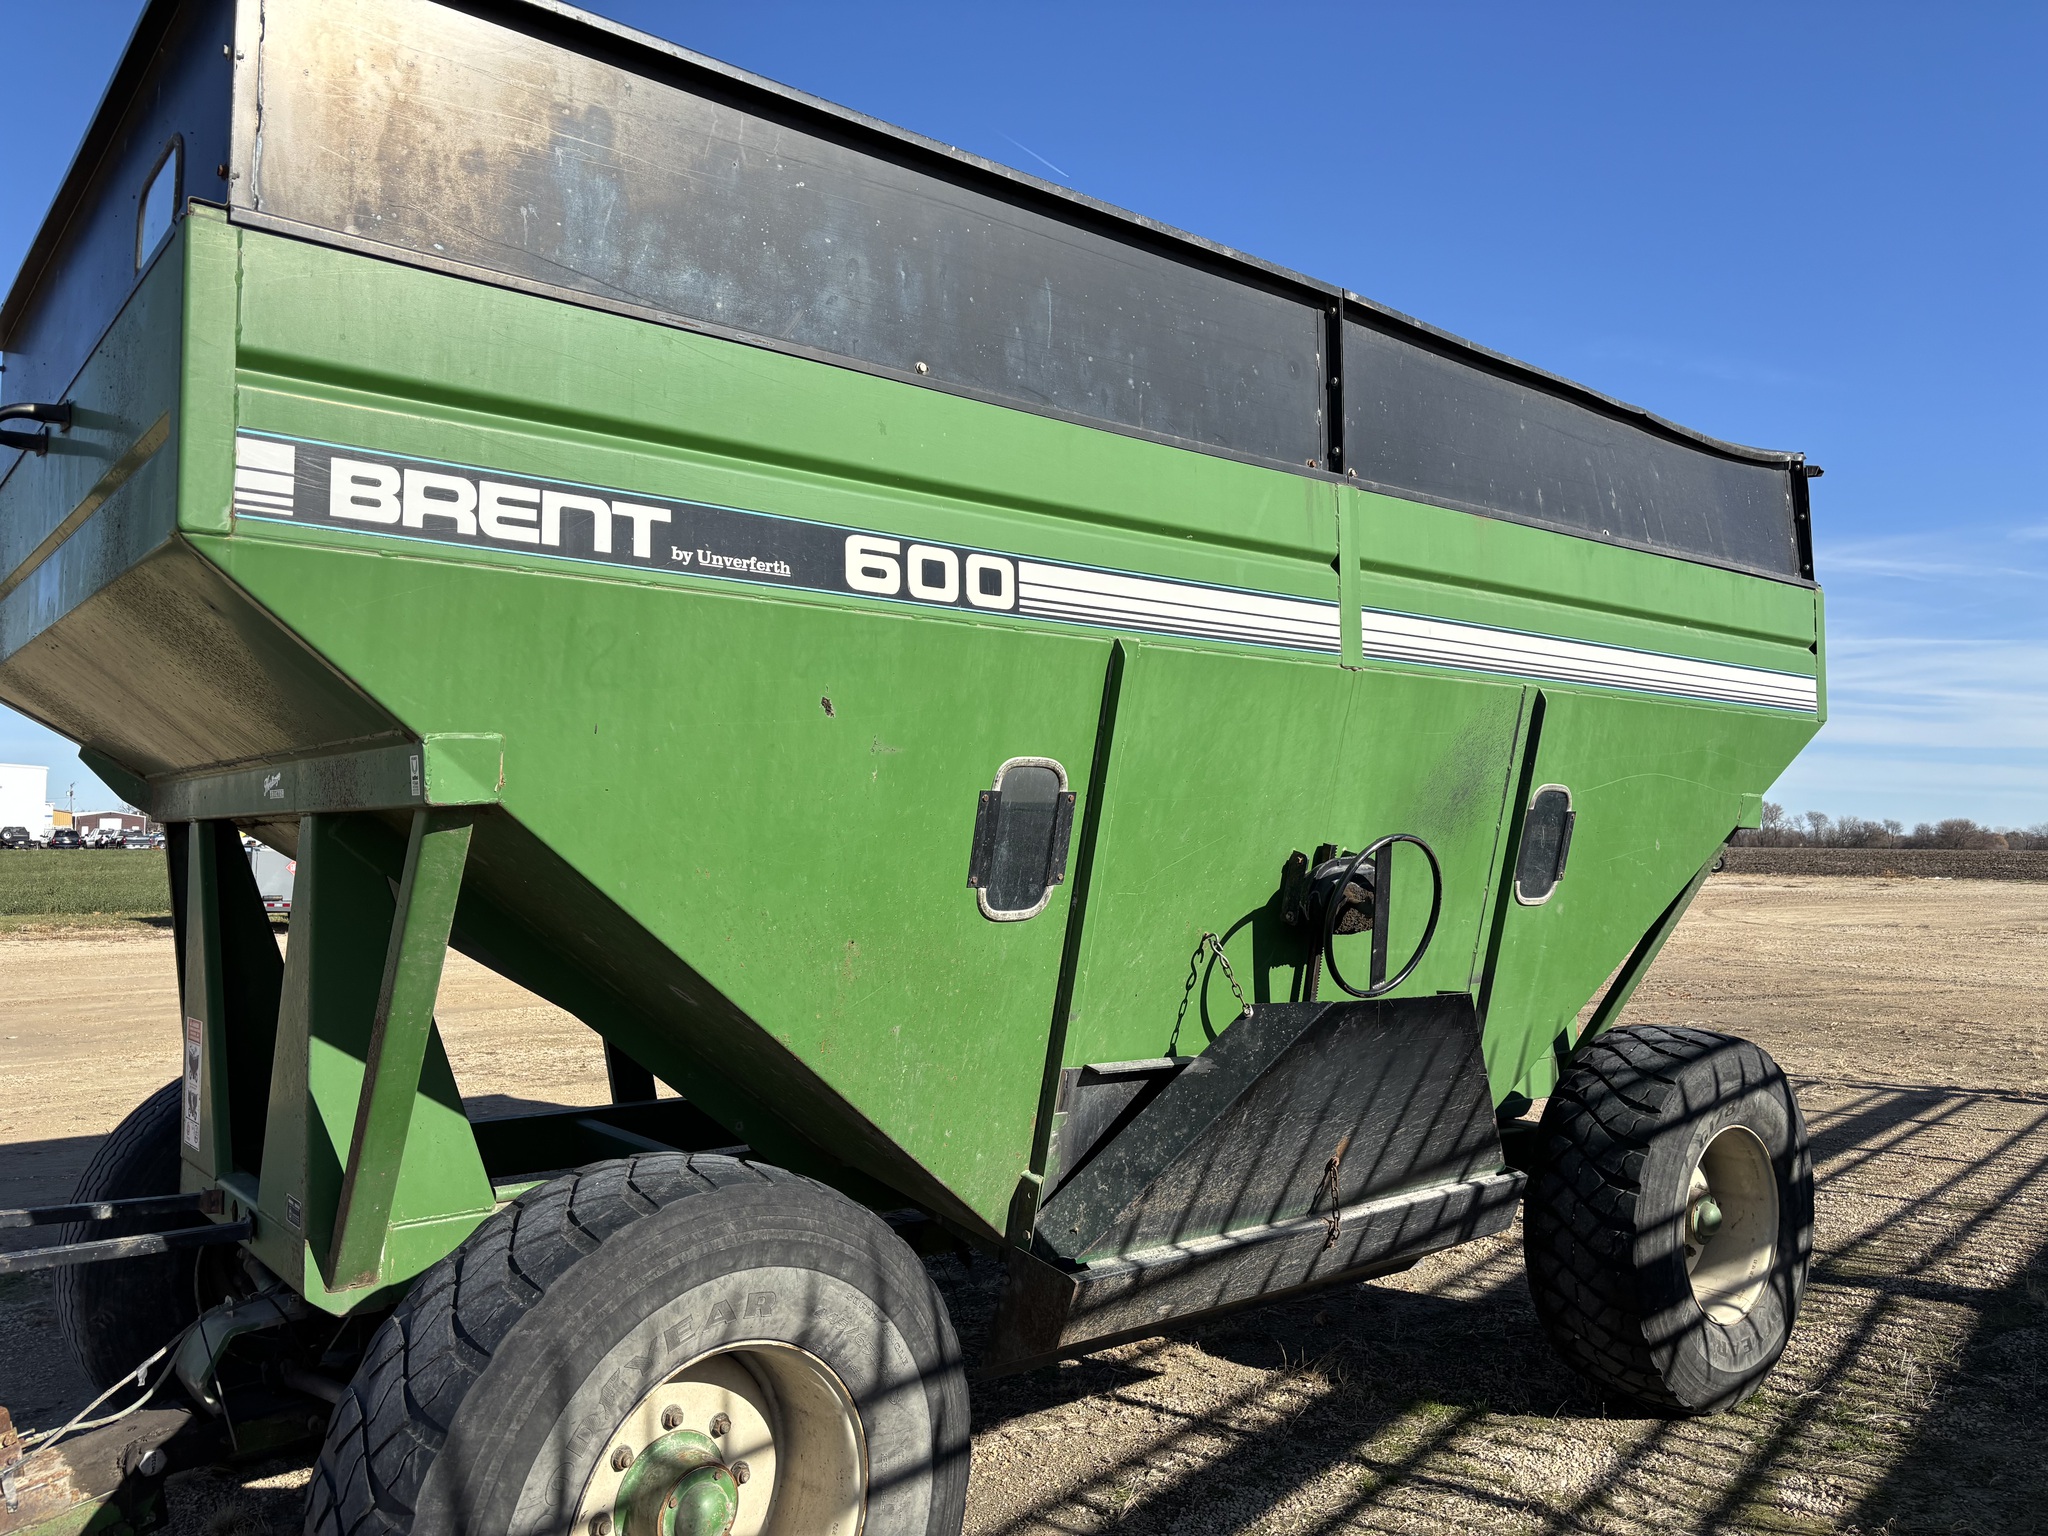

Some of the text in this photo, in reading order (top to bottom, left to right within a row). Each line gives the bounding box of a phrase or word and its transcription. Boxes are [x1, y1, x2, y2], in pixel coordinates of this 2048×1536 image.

[329, 456, 672, 559] BRENT
[670, 546, 792, 578] by Unverferth
[844, 534, 1016, 611] 600
